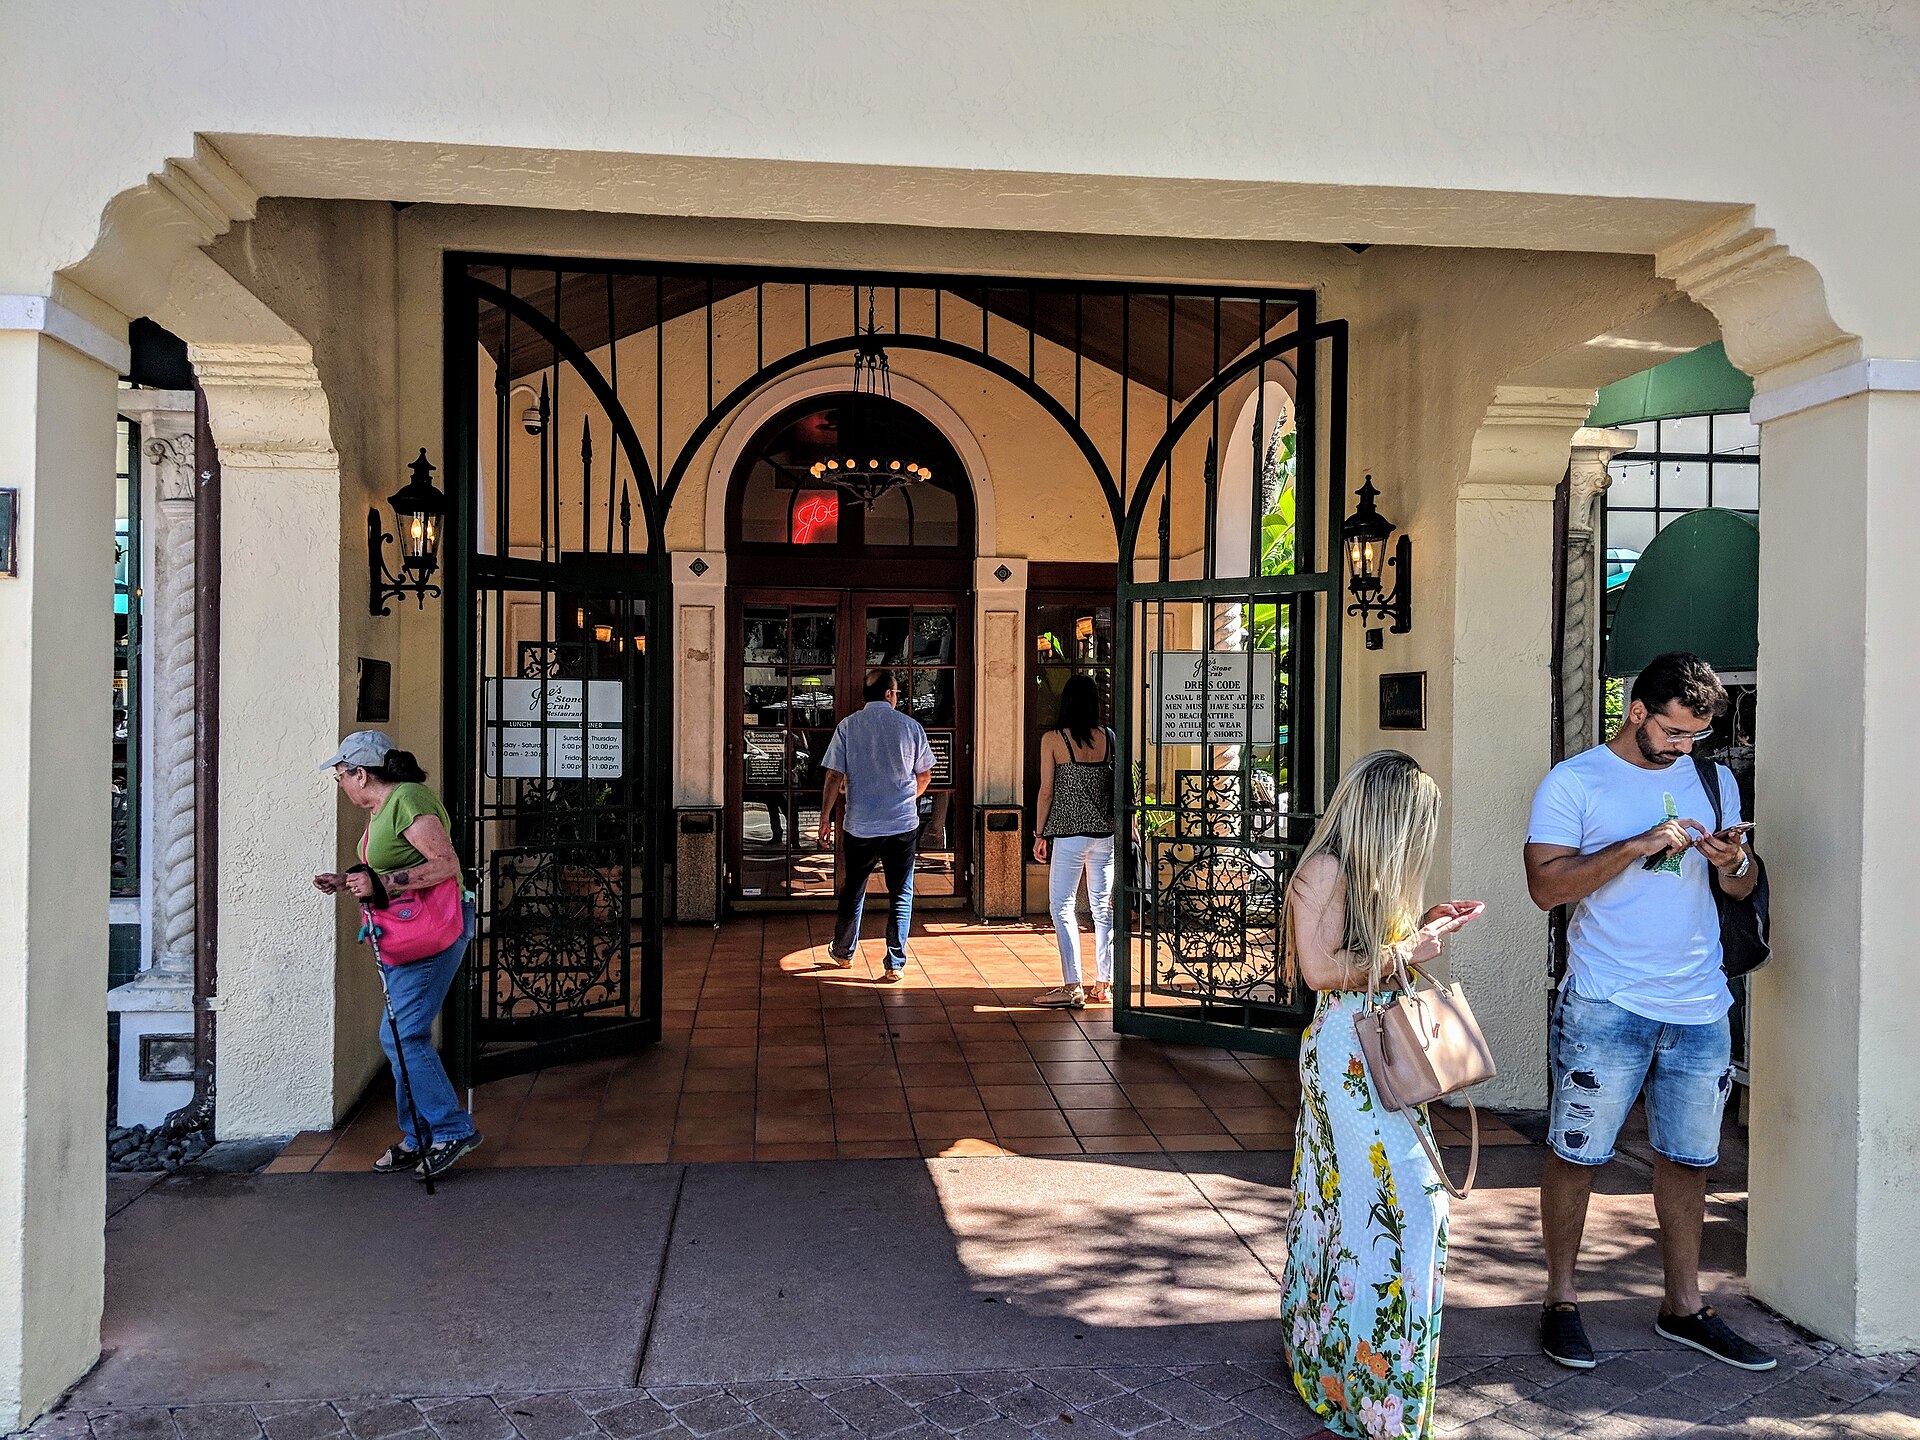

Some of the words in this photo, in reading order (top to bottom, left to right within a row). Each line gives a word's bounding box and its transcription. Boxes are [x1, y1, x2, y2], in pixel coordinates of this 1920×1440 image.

[1192, 657, 1216, 678] Je's
[1184, 680, 1214, 690] DRES
[1216, 680, 1241, 690] CODE
[529, 684, 562, 711] Je's
[1165, 721, 1176, 729] NO
[1178, 721, 1216, 729] ATHLEIC
[1218, 721, 1242, 729] WEAR
[1165, 730, 1176, 738] NO
[1179, 730, 1194, 738] CUT
[1196, 730, 1211, 738] OF
[1213, 730, 1244, 738] SHORTS
[591, 735, 618, 743] Thursday
[491, 741, 517, 749] Tuday
[521, 741, 549, 749] Saturd
[588, 754, 616, 762] Saturday
